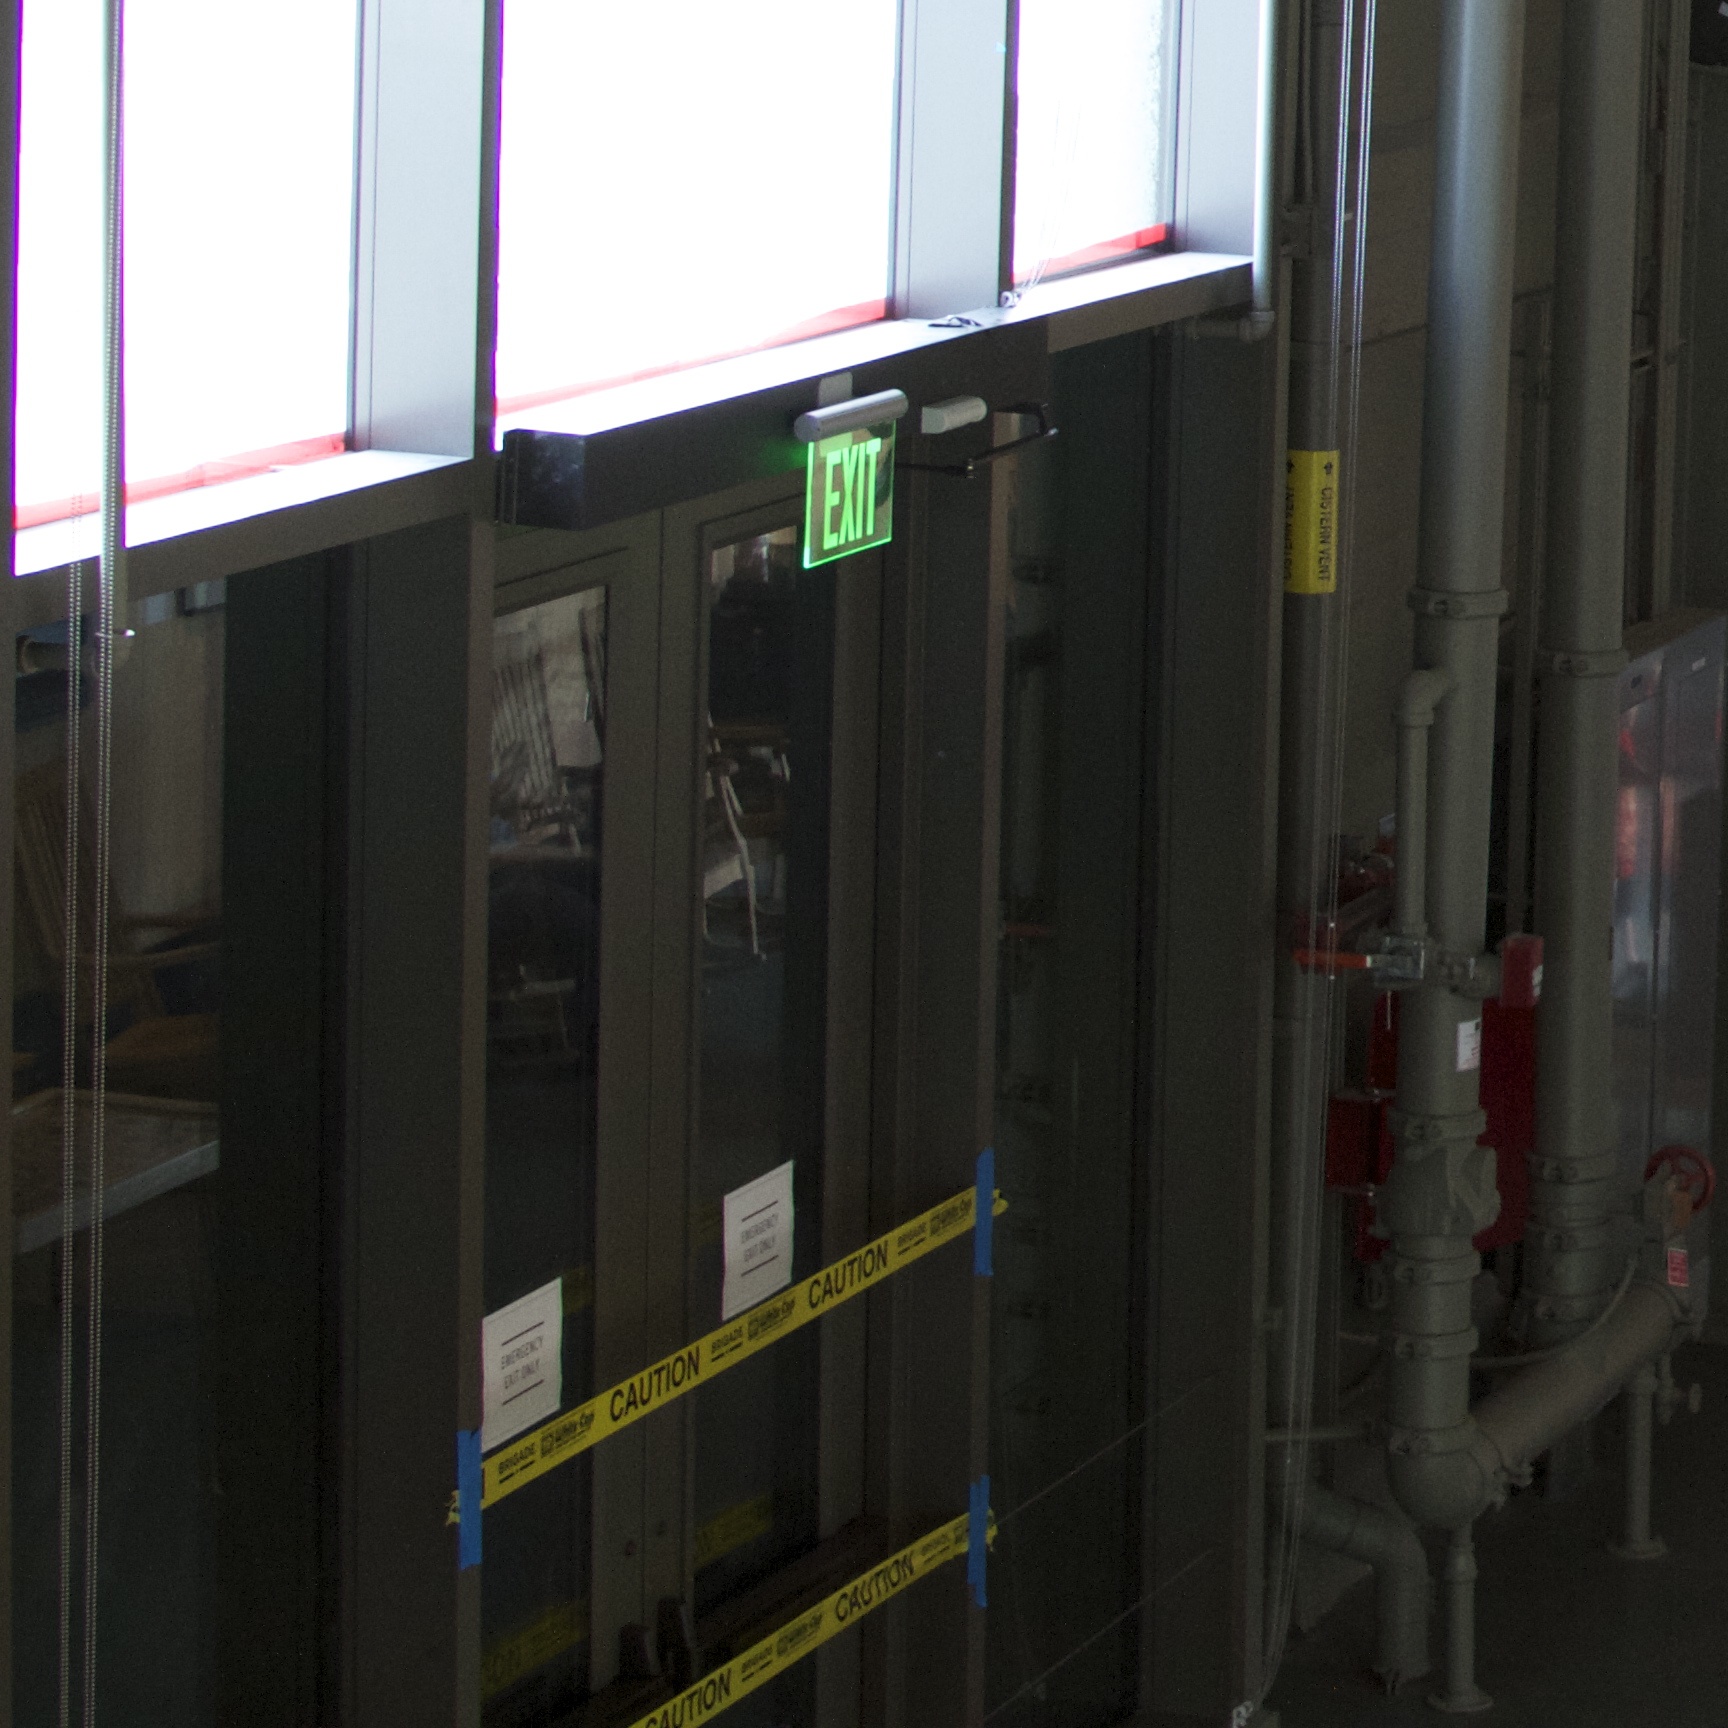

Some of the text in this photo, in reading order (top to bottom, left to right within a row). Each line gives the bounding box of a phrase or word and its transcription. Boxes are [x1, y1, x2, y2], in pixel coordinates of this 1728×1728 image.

[823, 437, 882, 551] EXIT
[1318, 486, 1333, 581] CISTERN VENT
[807, 1241, 888, 1310] CAUTION
[502, 1335, 545, 1370] EMERGENCY
[711, 1326, 743, 1354] BRIGADE
[504, 1369, 520, 1390] EXIT
[609, 1346, 700, 1423] CAUTION
[498, 1442, 536, 1474] BRIGADE
[834, 1549, 915, 1623] CAUTION
